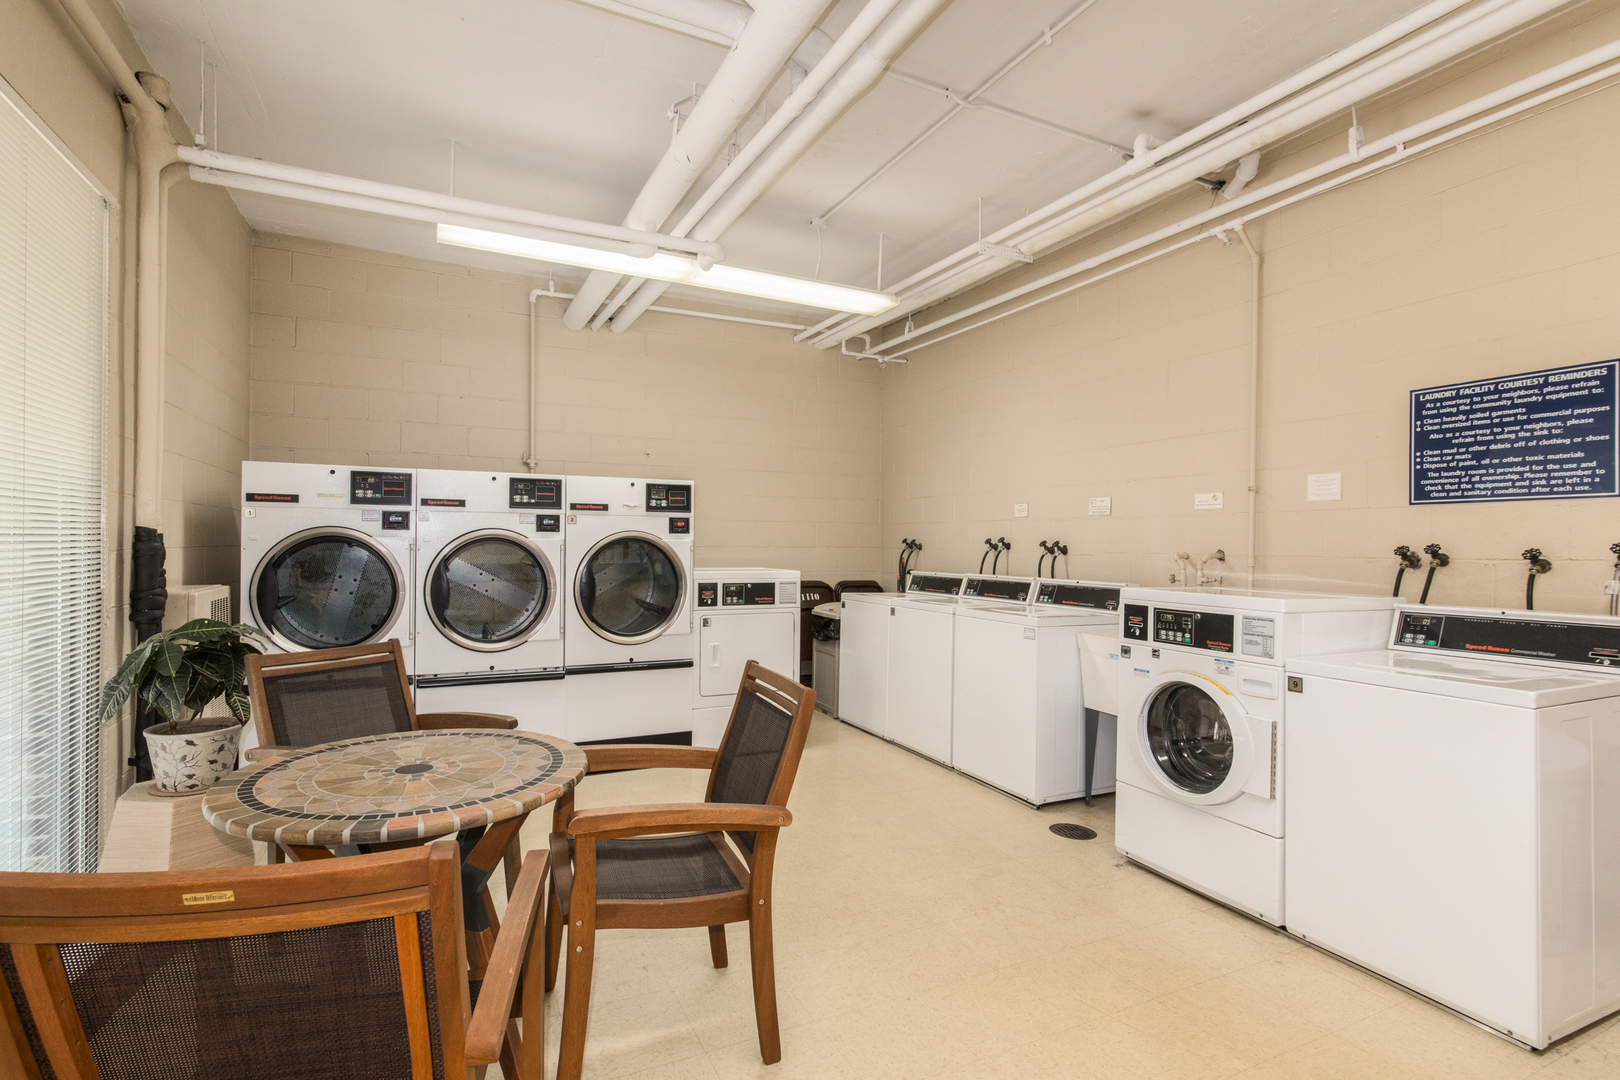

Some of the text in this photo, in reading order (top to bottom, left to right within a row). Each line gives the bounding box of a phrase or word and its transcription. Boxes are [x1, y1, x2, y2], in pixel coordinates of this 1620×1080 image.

[1420, 368, 1608, 401] LAUNDRY FACILITY COURTESY REMINDERS
[1443, 398, 1471, 406] courtesy
[1502, 388, 1541, 399] neighbors,
[1543, 384, 1569, 393] please
[1572, 380, 1600, 388] refrain
[1473, 400, 1512, 410] community
[1514, 395, 1543, 404] laundry
[1546, 390, 1589, 400] equipment
[1443, 414, 1466, 422] heavily
[1491, 407, 1526, 417] garments
[1530, 409, 1571, 418] commercial
[1574, 405, 1610, 415] purposes
[1523, 420, 1563, 430] neighbors,
[1539, 437, 1570, 446] clothing
[1475, 481, 1512, 489] equipment
[1464, 488, 1491, 497] sanitary
